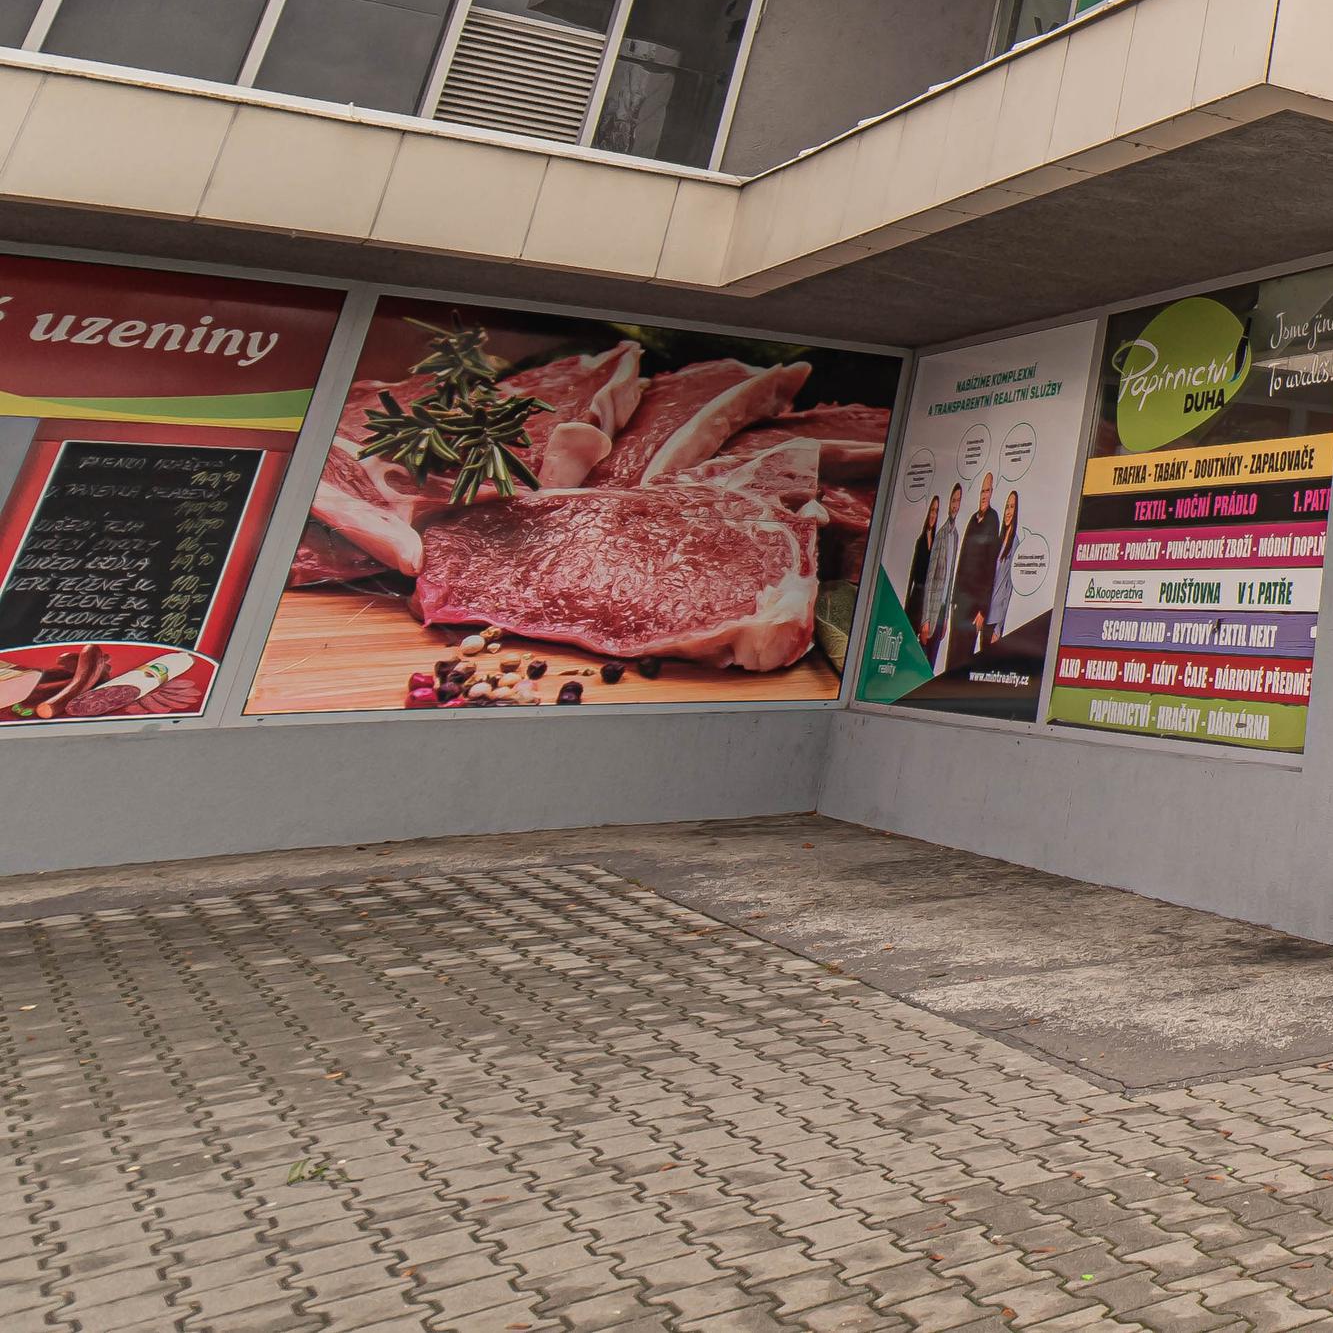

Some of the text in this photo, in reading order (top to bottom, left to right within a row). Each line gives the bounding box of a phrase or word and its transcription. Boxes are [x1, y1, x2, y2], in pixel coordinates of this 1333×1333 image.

[29, 315, 279, 367] uzeniny
[1270, 312, 1310, 349] Jsme
[956, 362, 1038, 394] NABÍZÍME KOMPLEXNÍ
[1112, 338, 1233, 412] Papírnictví
[1267, 362, 1281, 397] To
[933, 391, 994, 416] TRANSPARENTNÍ
[993, 388, 1029, 406] REALITNÍ
[1029, 380, 1062, 400] SLUŽBY
[1183, 388, 1225, 414] DUHA
[1112, 444, 1315, 486] TRAFIKA TABÁKY DOUTNÍKY ZAPALOVAČE
[1134, 499, 1167, 522] TEXTIL
[1175, 490, 1213, 520] NOČNÍ
[1213, 491, 1258, 517] PRÁDLO
[1076, 539, 1121, 562] GALANTERIE
[1124, 537, 1161, 561] PONOŽKY
[1166, 535, 1226, 560] PUNČOCHOVÉ
[1225, 531, 1253, 559] ZBOŽÍ
[1258, 533, 1294, 558] MÓDNÍ
[1095, 581, 1144, 601] Kooperativa
[1159, 577, 1221, 604] POJIŠŤOVNA
[1237, 582, 1247, 604] V
[1257, 577, 1293, 605] PATŘE
[1101, 620, 1137, 642] SECOND
[1139, 621, 1166, 643] HAND
[1172, 619, 1214, 645] BYTOVÝ
[1248, 624, 1278, 648] NEXT
[878, 662, 897, 677] reality
[969, 670, 1030, 688] www.mintreality.cz
[1059, 658, 1082, 679] ALKO
[1085, 659, 1118, 682] NEALKO
[1123, 658, 1146, 684] VÍNO
[1151, 660, 1178, 686] KÁVY
[1183, 661, 1208, 689] ČAJE
[1214, 666, 1264, 693] DÁRKOVÉ
[1089, 698, 1269, 741] PAPÍRNICTVÍ HRAČKY DÁRKÁRNA
